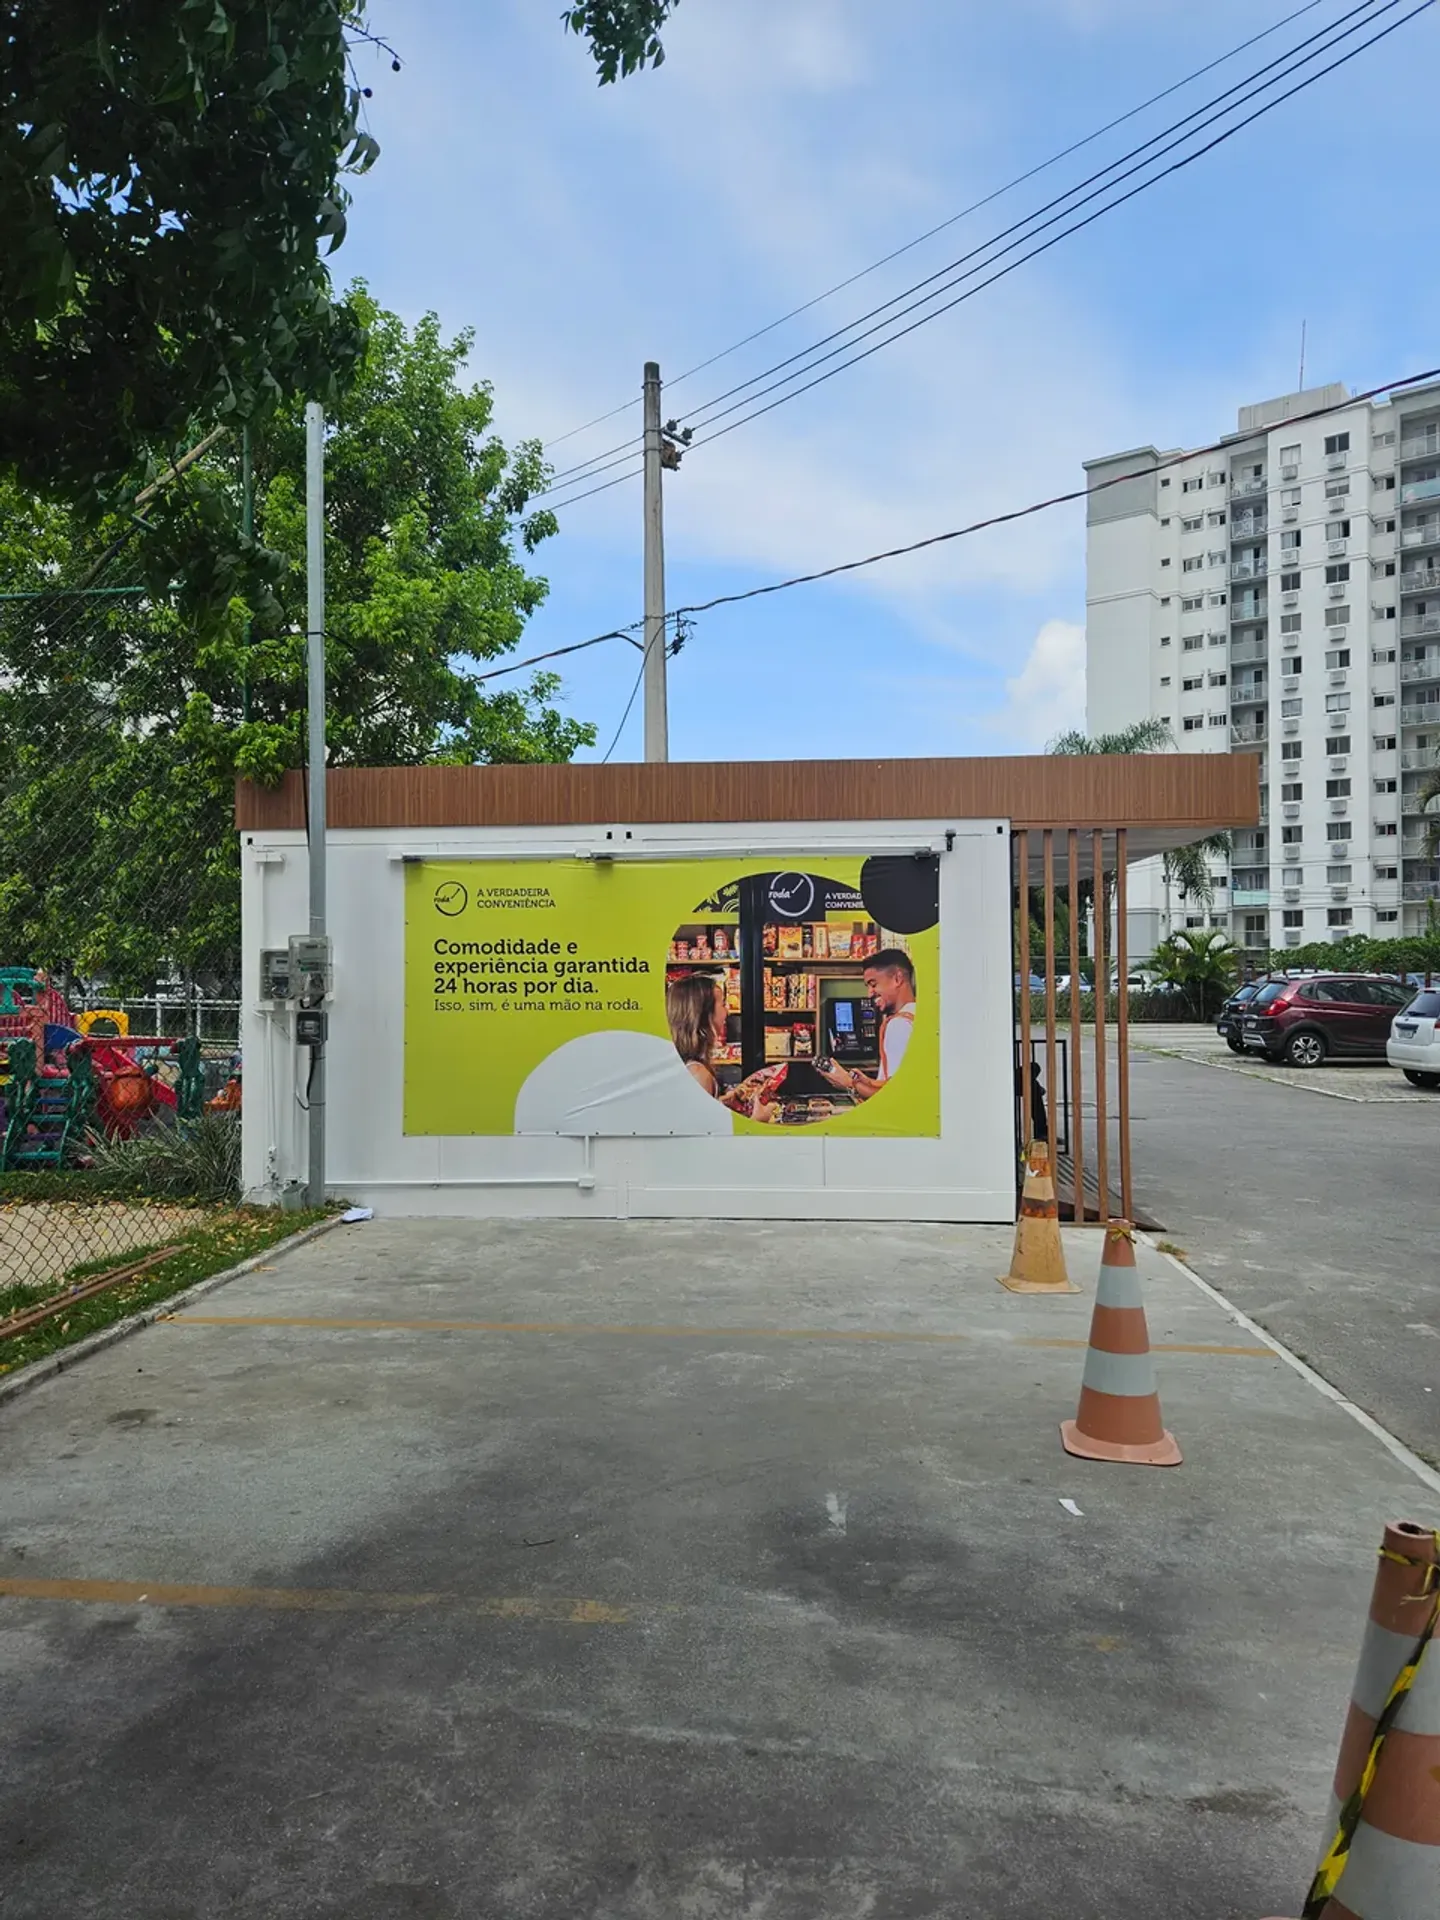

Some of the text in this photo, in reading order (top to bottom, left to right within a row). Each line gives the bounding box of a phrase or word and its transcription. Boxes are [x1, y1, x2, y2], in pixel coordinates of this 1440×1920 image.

[477, 888, 550, 897] A VERDADEIRA
[768, 888, 791, 899] roda
[476, 898, 557, 909] CONVENIÊNCIA
[433, 938, 578, 956] Comodidade e
[433, 956, 650, 979] experiência garantida
[433, 976, 599, 998] 24 horas por dia.
[434, 998, 644, 1013] Isso, sim, é uma mão na roda.
